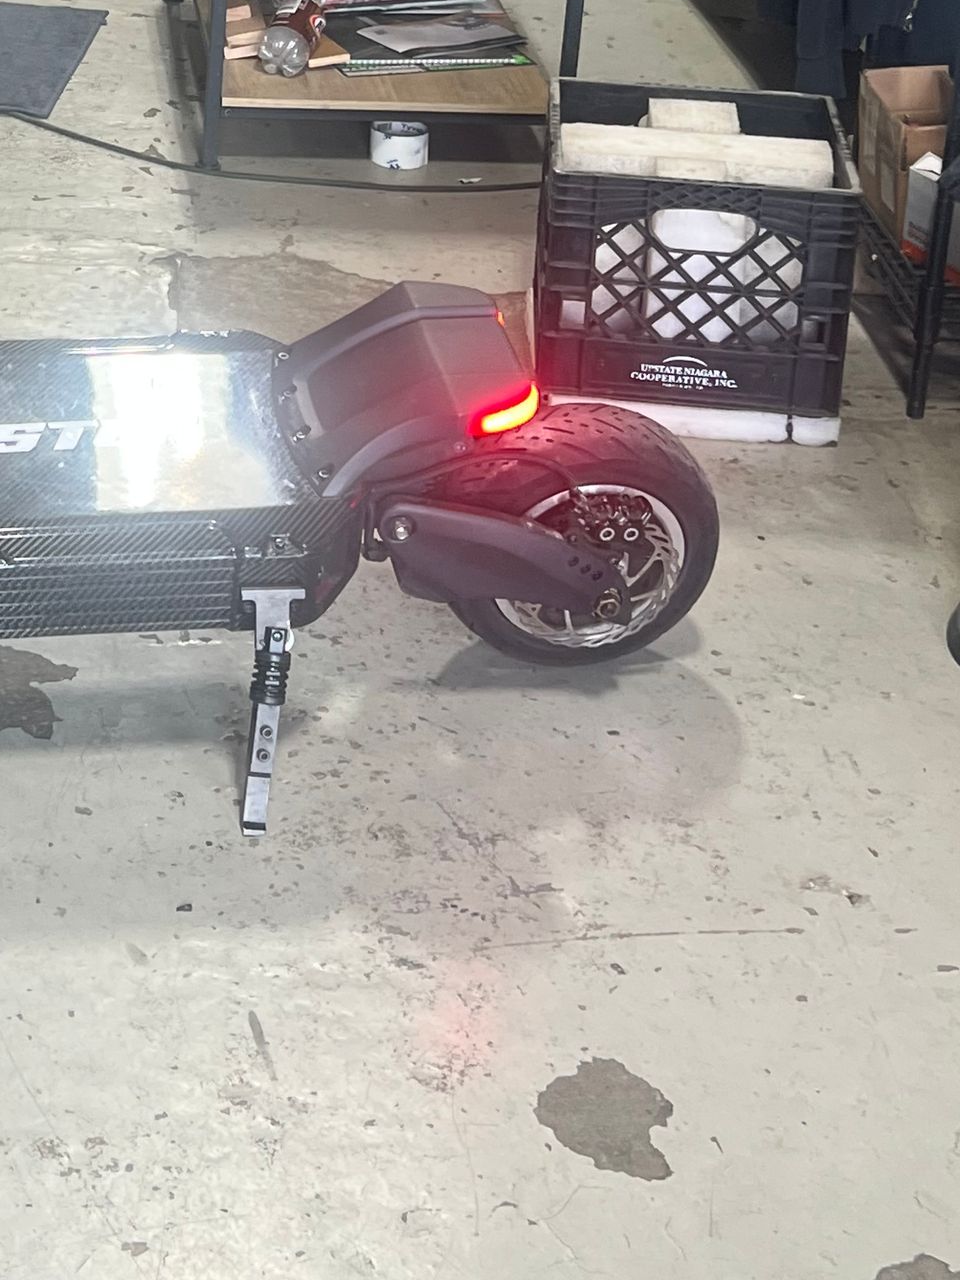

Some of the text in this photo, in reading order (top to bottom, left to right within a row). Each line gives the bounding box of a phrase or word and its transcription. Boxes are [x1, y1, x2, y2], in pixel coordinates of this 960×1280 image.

[640, 362, 728, 379] UPSTATE NIAGARA
[630, 371, 713, 388] COOPERATIVE,
[715, 378, 738, 390] INC.
